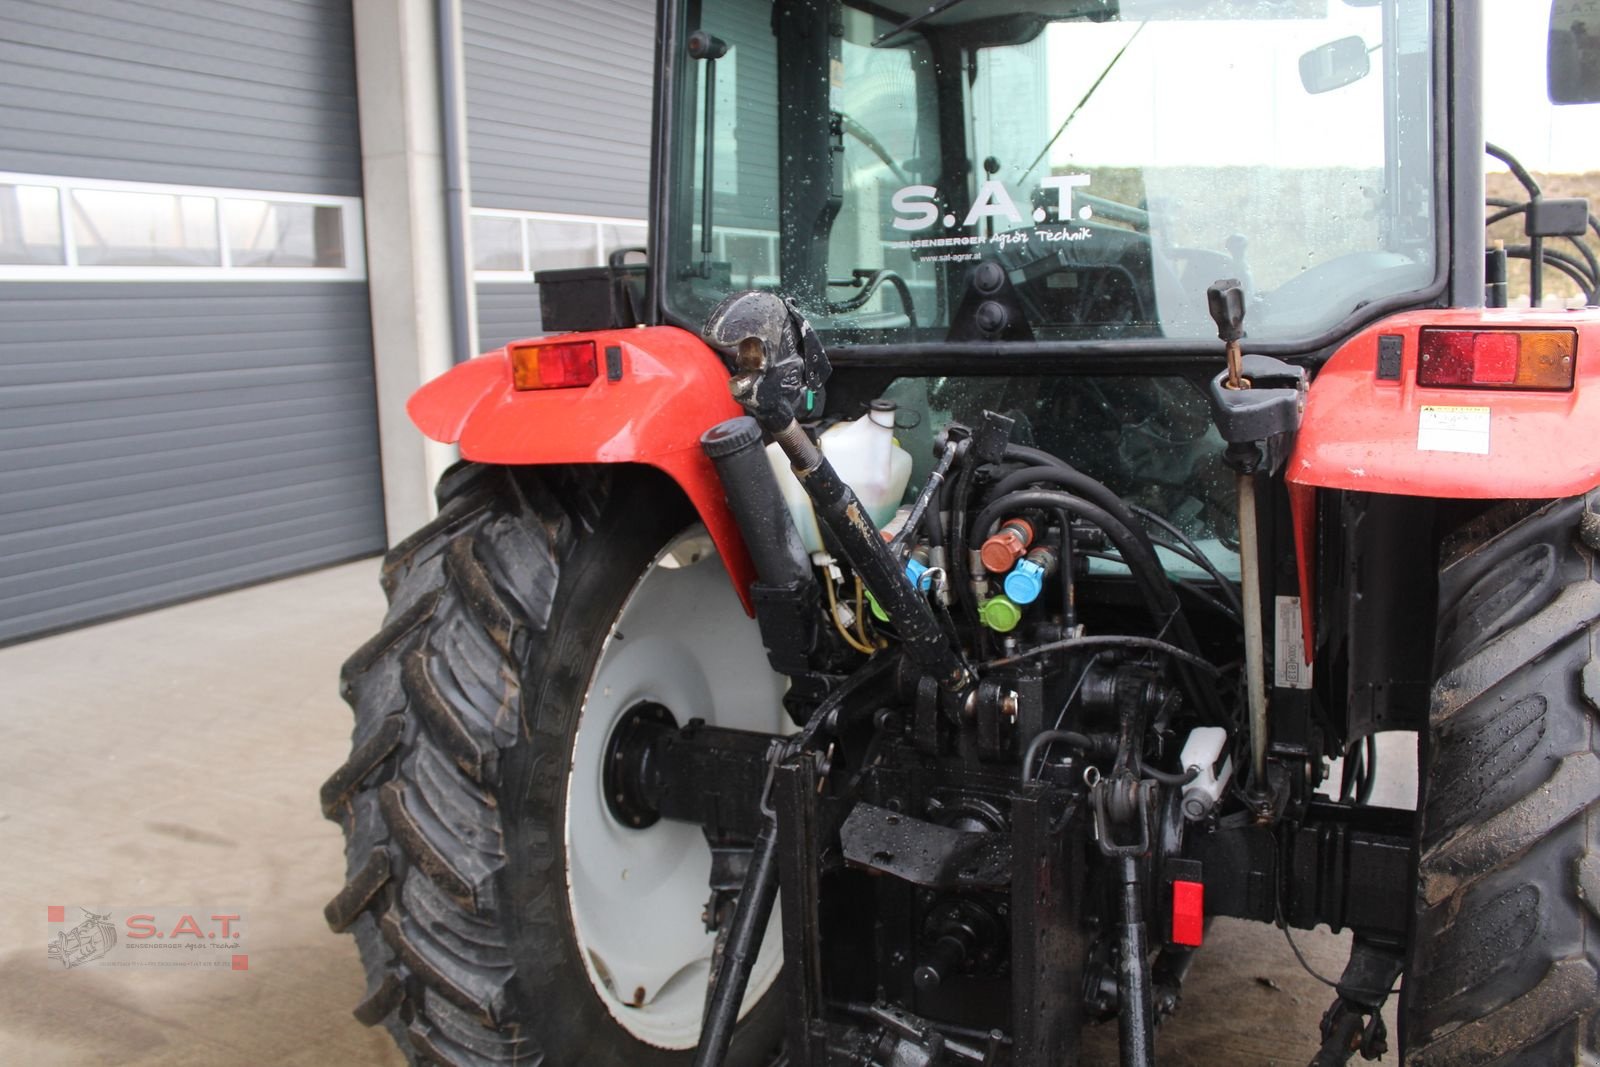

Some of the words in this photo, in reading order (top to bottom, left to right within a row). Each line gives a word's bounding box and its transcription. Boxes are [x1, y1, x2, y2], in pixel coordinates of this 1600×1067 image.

[891, 174, 1093, 231] S.A.T.
[1035, 227, 1093, 242] Technik
[919, 252, 982, 263] www.sat-agrar.at
